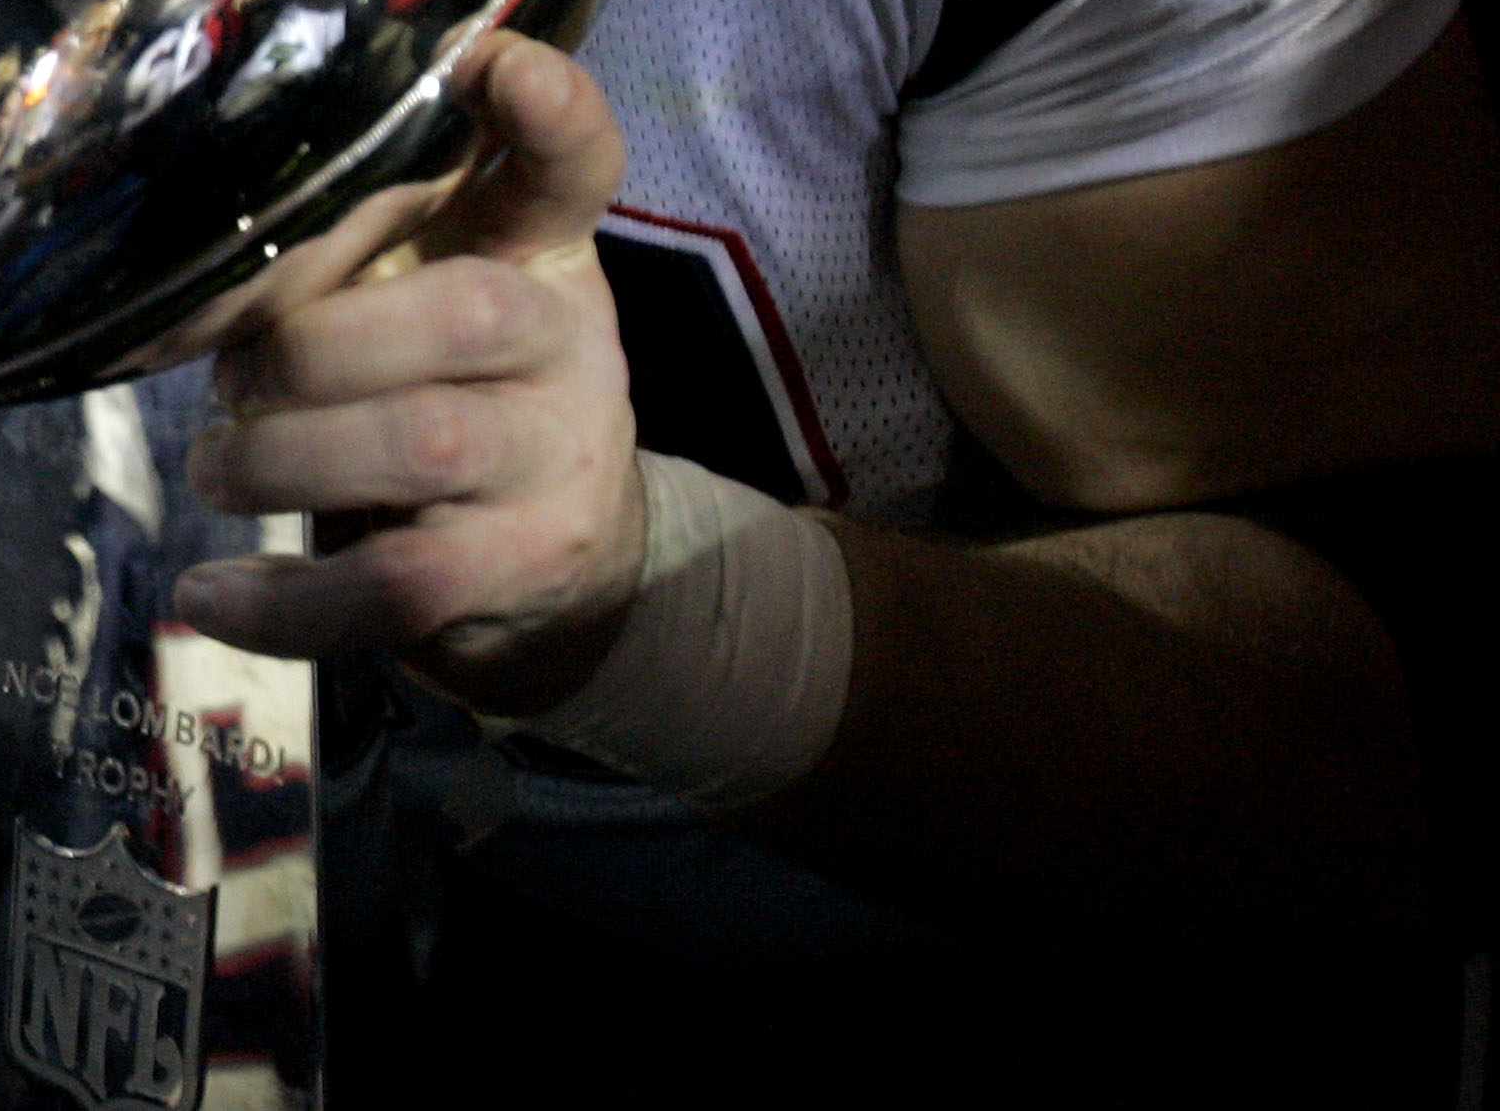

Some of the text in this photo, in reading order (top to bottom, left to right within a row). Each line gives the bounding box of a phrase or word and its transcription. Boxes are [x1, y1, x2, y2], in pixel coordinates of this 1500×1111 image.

[52, 743, 197, 818] TROPHY
[92, 687, 289, 787] LOMBARDI
[18, 941, 186, 1107] NFL
